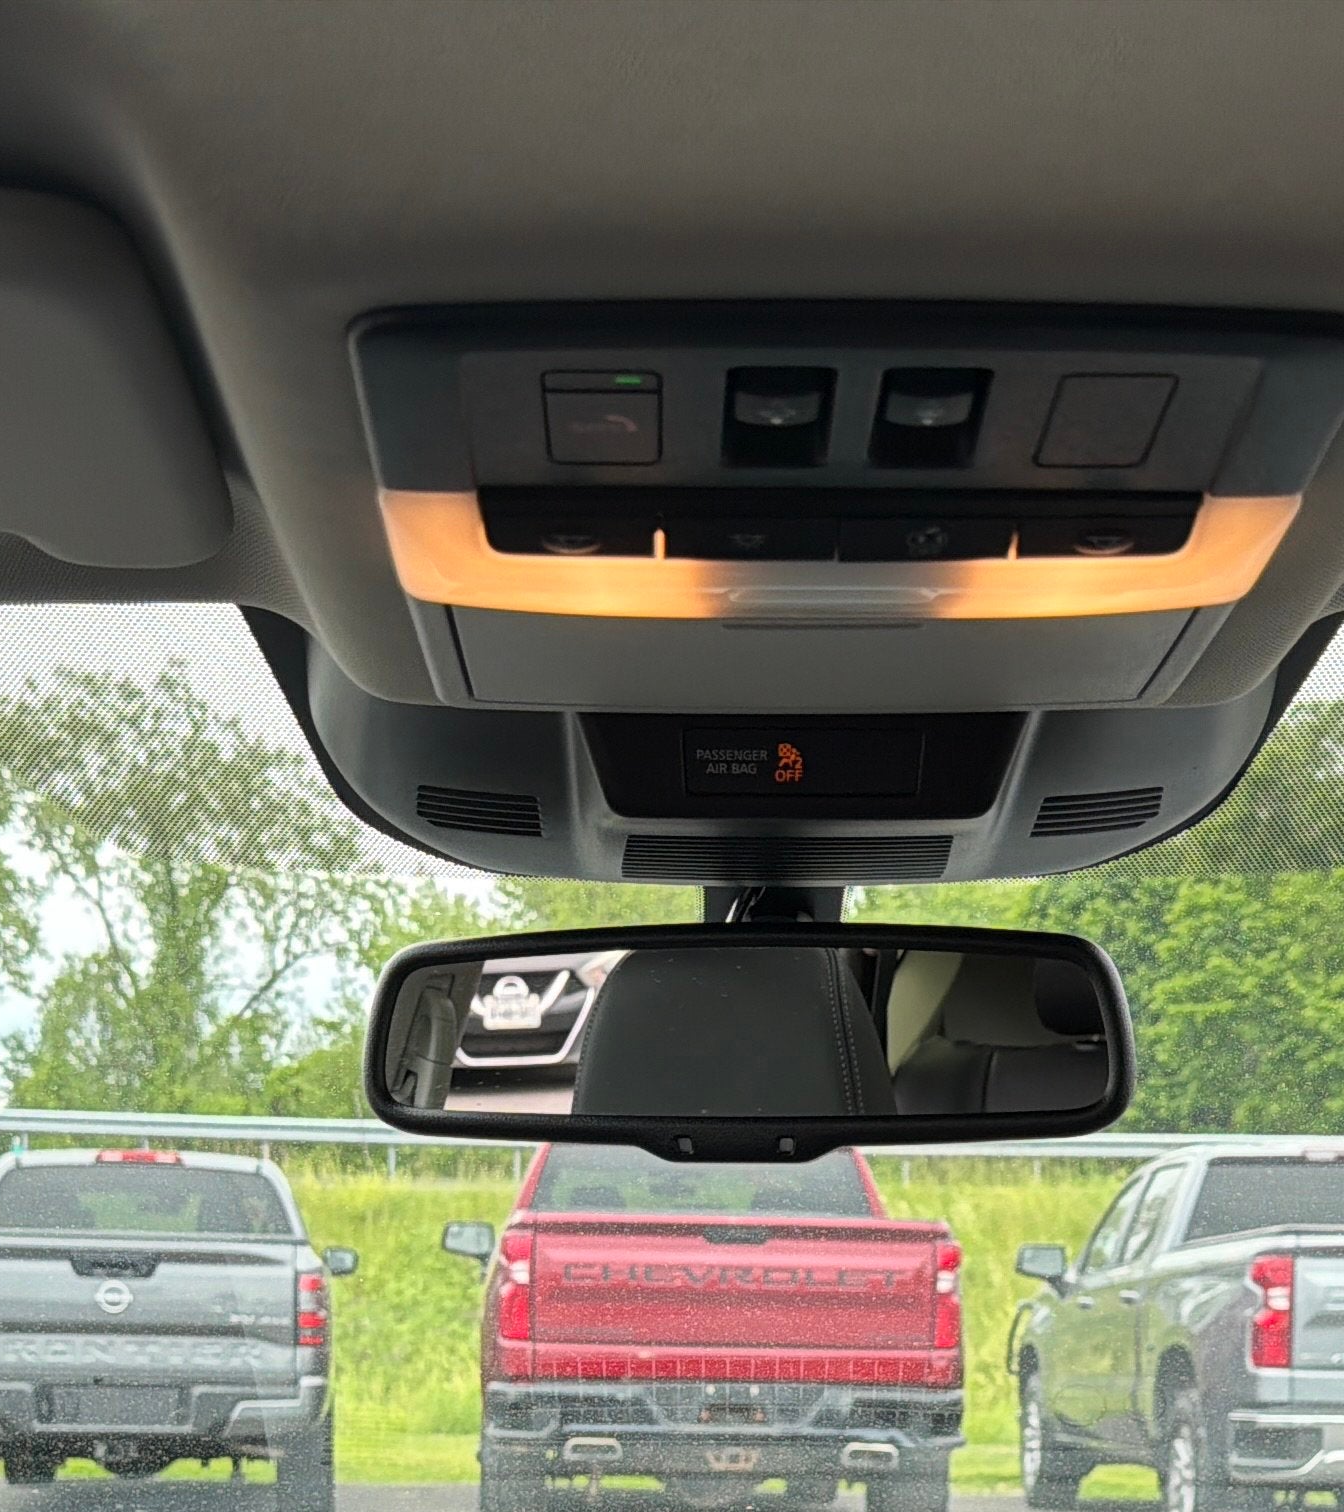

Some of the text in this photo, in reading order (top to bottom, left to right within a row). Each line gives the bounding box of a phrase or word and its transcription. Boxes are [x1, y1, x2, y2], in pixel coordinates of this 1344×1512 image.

[696, 749, 768, 761] PASSENGER
[706, 763, 757, 774] AIR BAG
[775, 770, 803, 782] OFF
[562, 1261, 912, 1291] CHEVROLET
